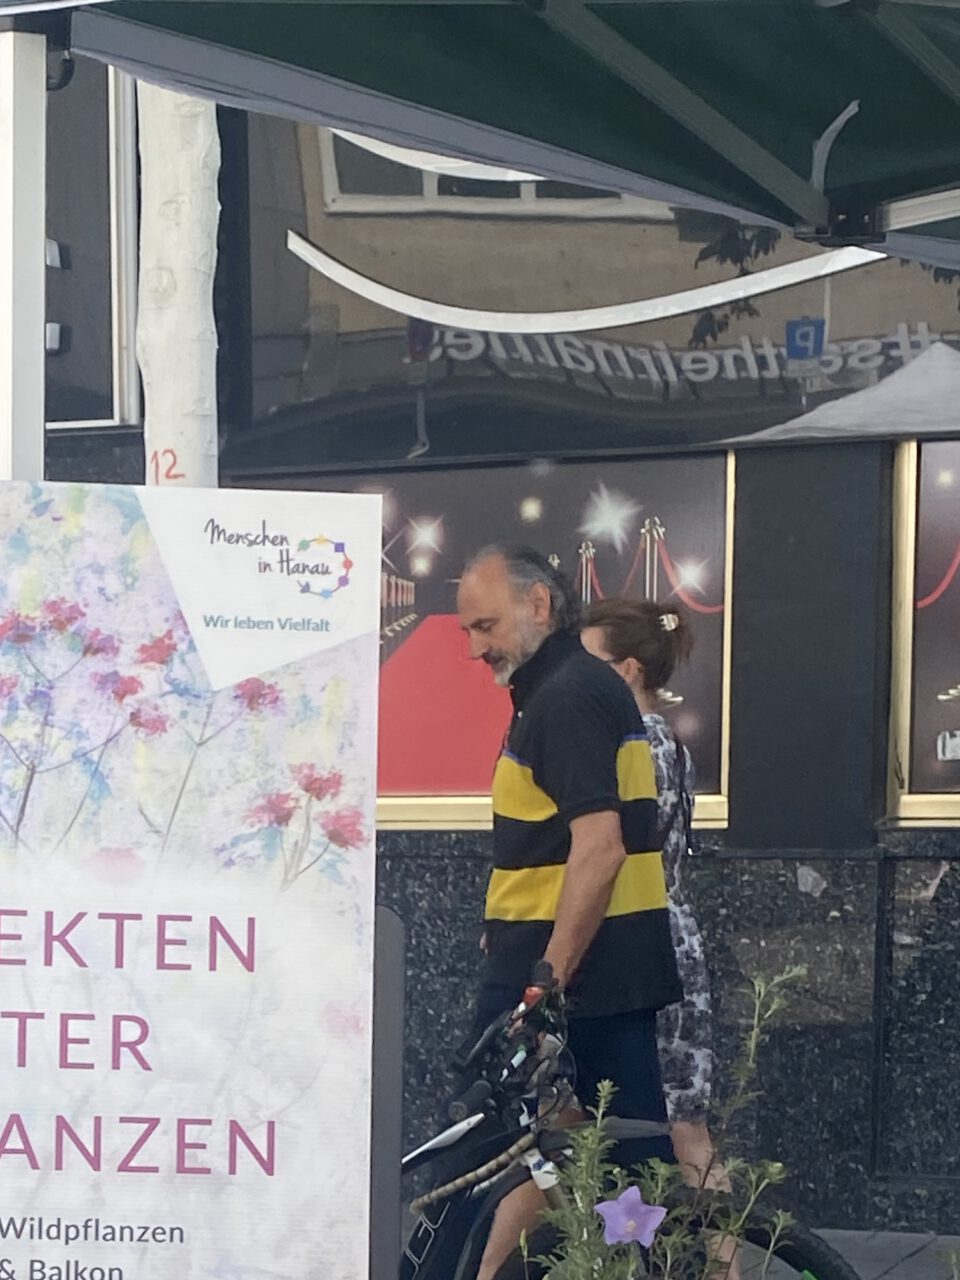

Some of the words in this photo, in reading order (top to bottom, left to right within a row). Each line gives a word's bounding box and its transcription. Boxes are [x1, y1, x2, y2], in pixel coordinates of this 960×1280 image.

[150, 449, 186, 485] 12
[204, 518, 290, 547] Menschen
[258, 557, 272, 573] in
[277, 549, 332, 576] Hanau
[203, 615, 231, 629] Wir
[234, 616, 274, 630] leben
[277, 618, 330, 632] Vielfalt
